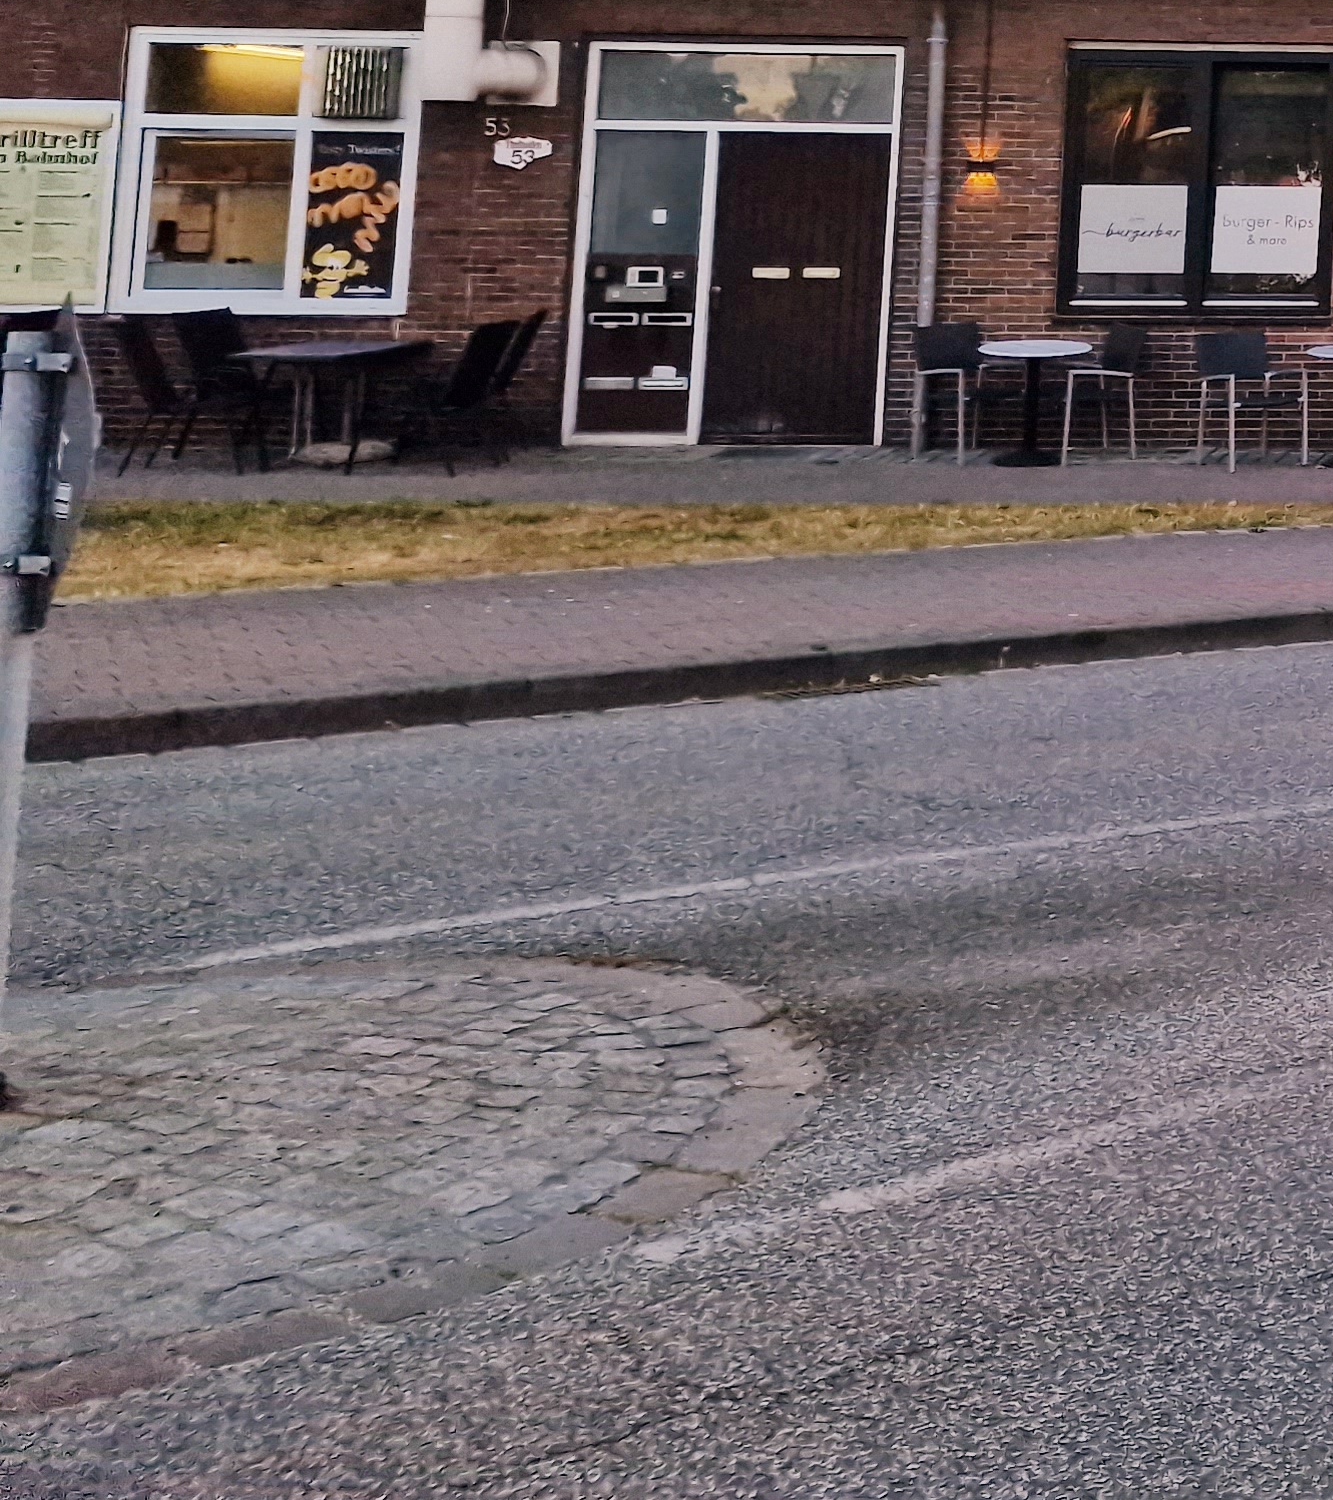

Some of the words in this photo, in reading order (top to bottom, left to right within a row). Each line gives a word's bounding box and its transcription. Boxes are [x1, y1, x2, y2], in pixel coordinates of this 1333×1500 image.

[484, 117, 510, 137] 53
[511, 150, 535, 165] 53
[1285, 214, 1315, 229] Rips
[1082, 222, 1183, 242] burgerbar
[1246, 235, 1255, 245] &
